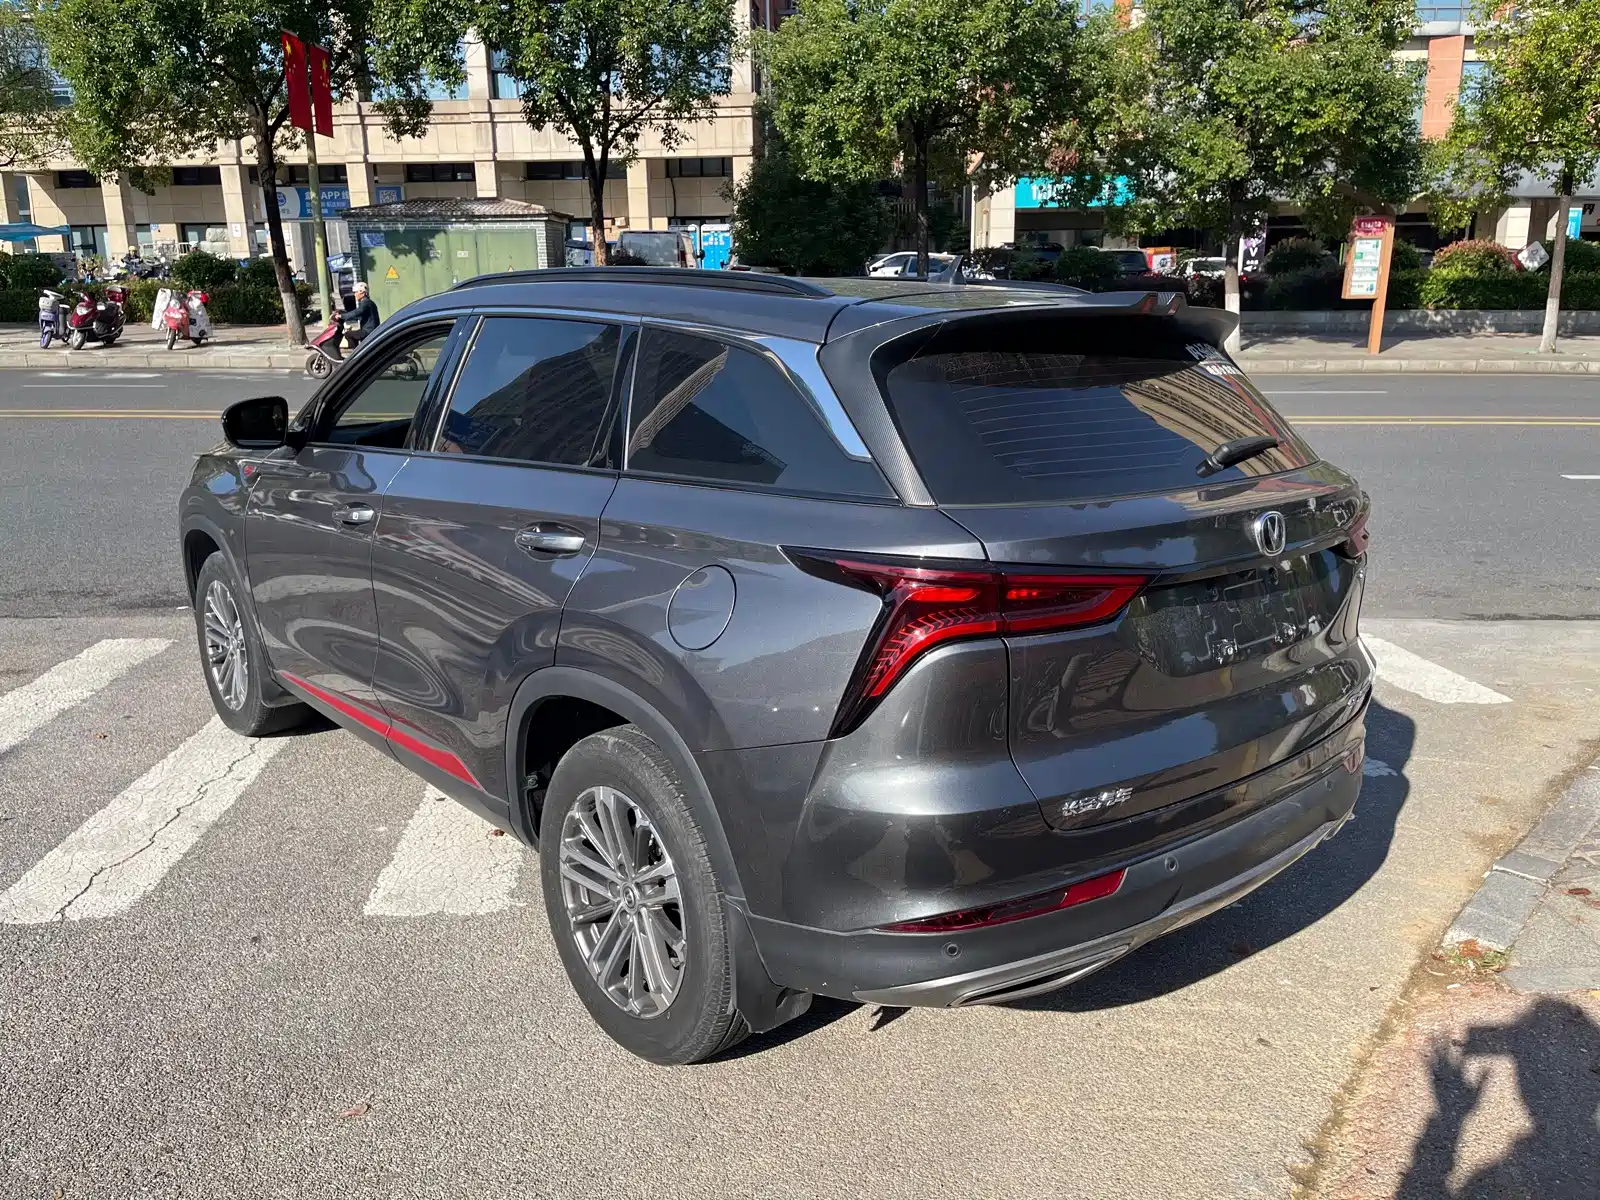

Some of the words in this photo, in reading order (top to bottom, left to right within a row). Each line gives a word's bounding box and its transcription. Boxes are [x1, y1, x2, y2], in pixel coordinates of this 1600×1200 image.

[321, 191, 341, 200] APP
[1062, 786, 1133, 817] 长安汽车
